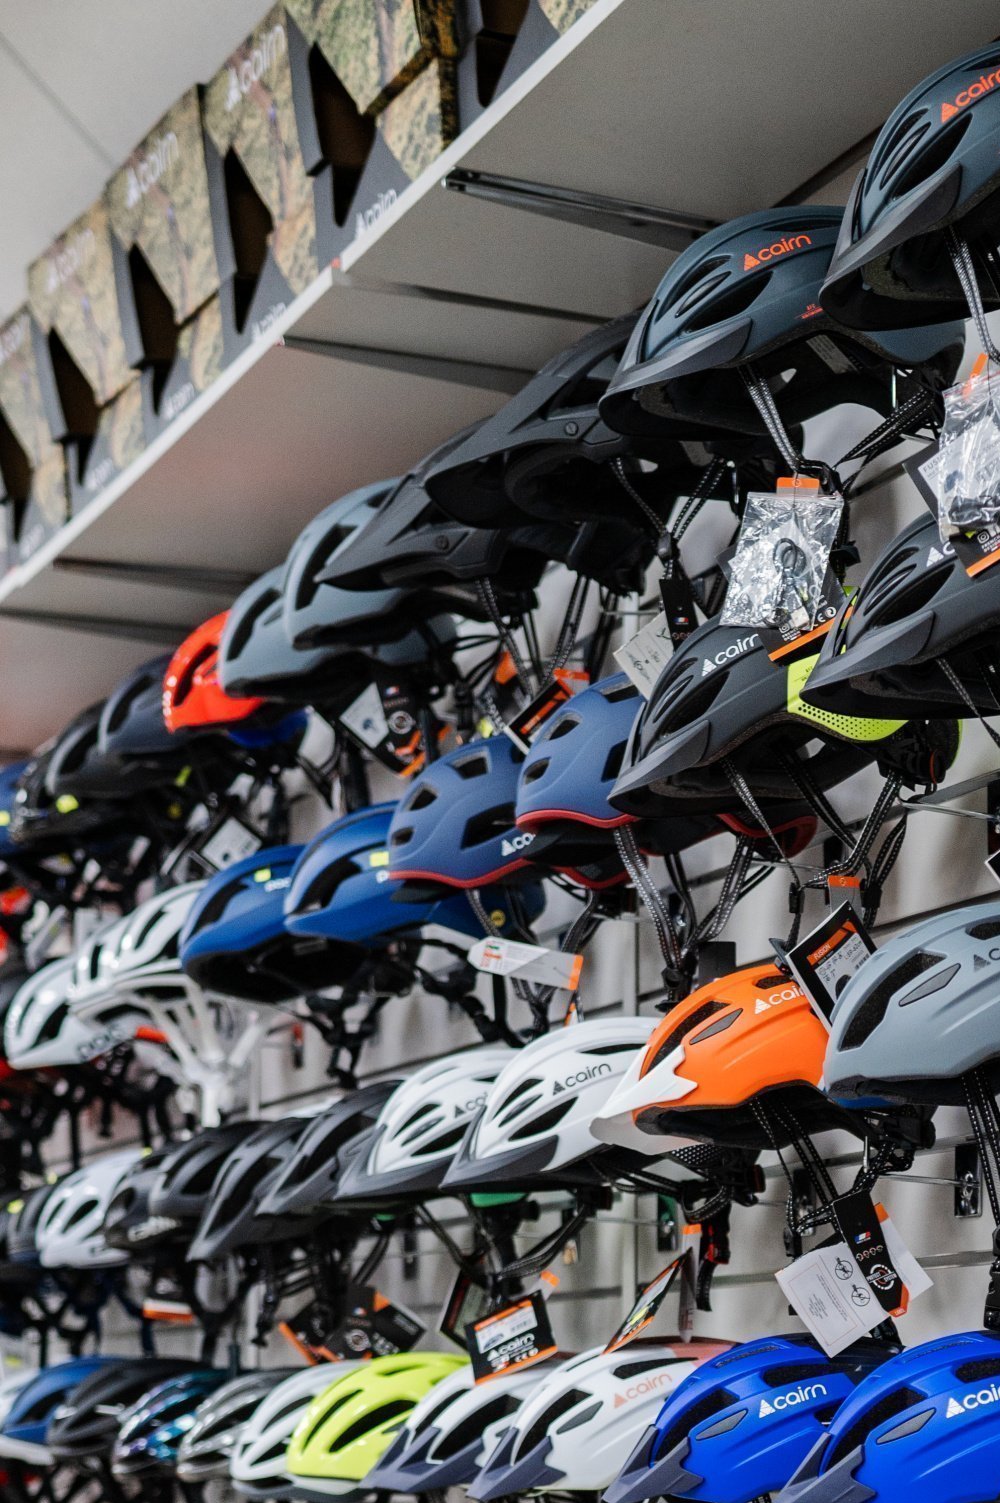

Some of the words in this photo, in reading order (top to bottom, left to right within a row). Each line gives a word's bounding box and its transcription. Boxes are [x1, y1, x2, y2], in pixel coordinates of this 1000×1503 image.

[758, 233, 812, 261] cairn
[814, 943, 831, 961] FUSION
[769, 984, 806, 1006] cair
[565, 1062, 613, 1089] cairn
[623, 1371, 674, 1402] cairn
[775, 1381, 827, 1408] cairn
